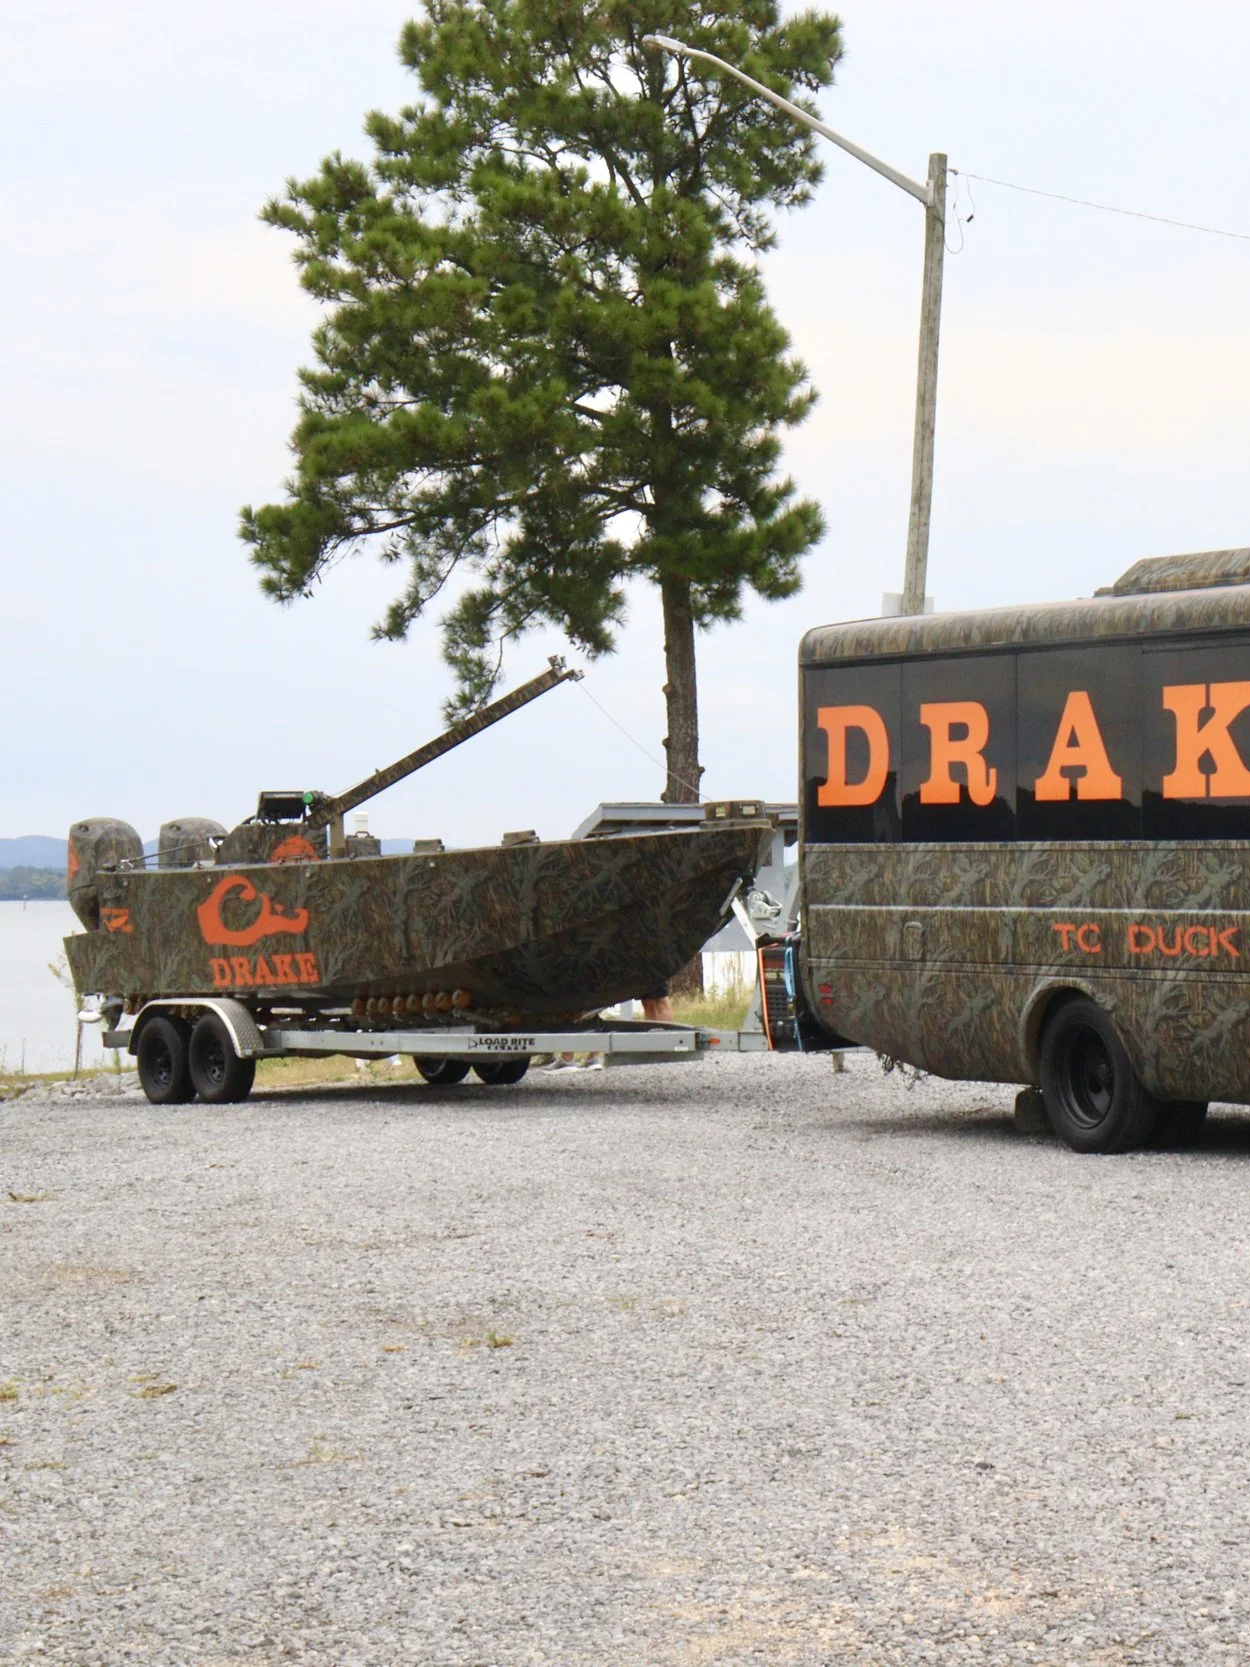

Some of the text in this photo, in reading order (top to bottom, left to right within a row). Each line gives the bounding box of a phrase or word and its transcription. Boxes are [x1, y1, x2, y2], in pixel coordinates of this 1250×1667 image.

[1053, 923, 1100, 953] TC
[1127, 924, 1241, 957] DUCK
[210, 953, 320, 987] DRAKE
[479, 1038, 536, 1046] LOAD RITE
